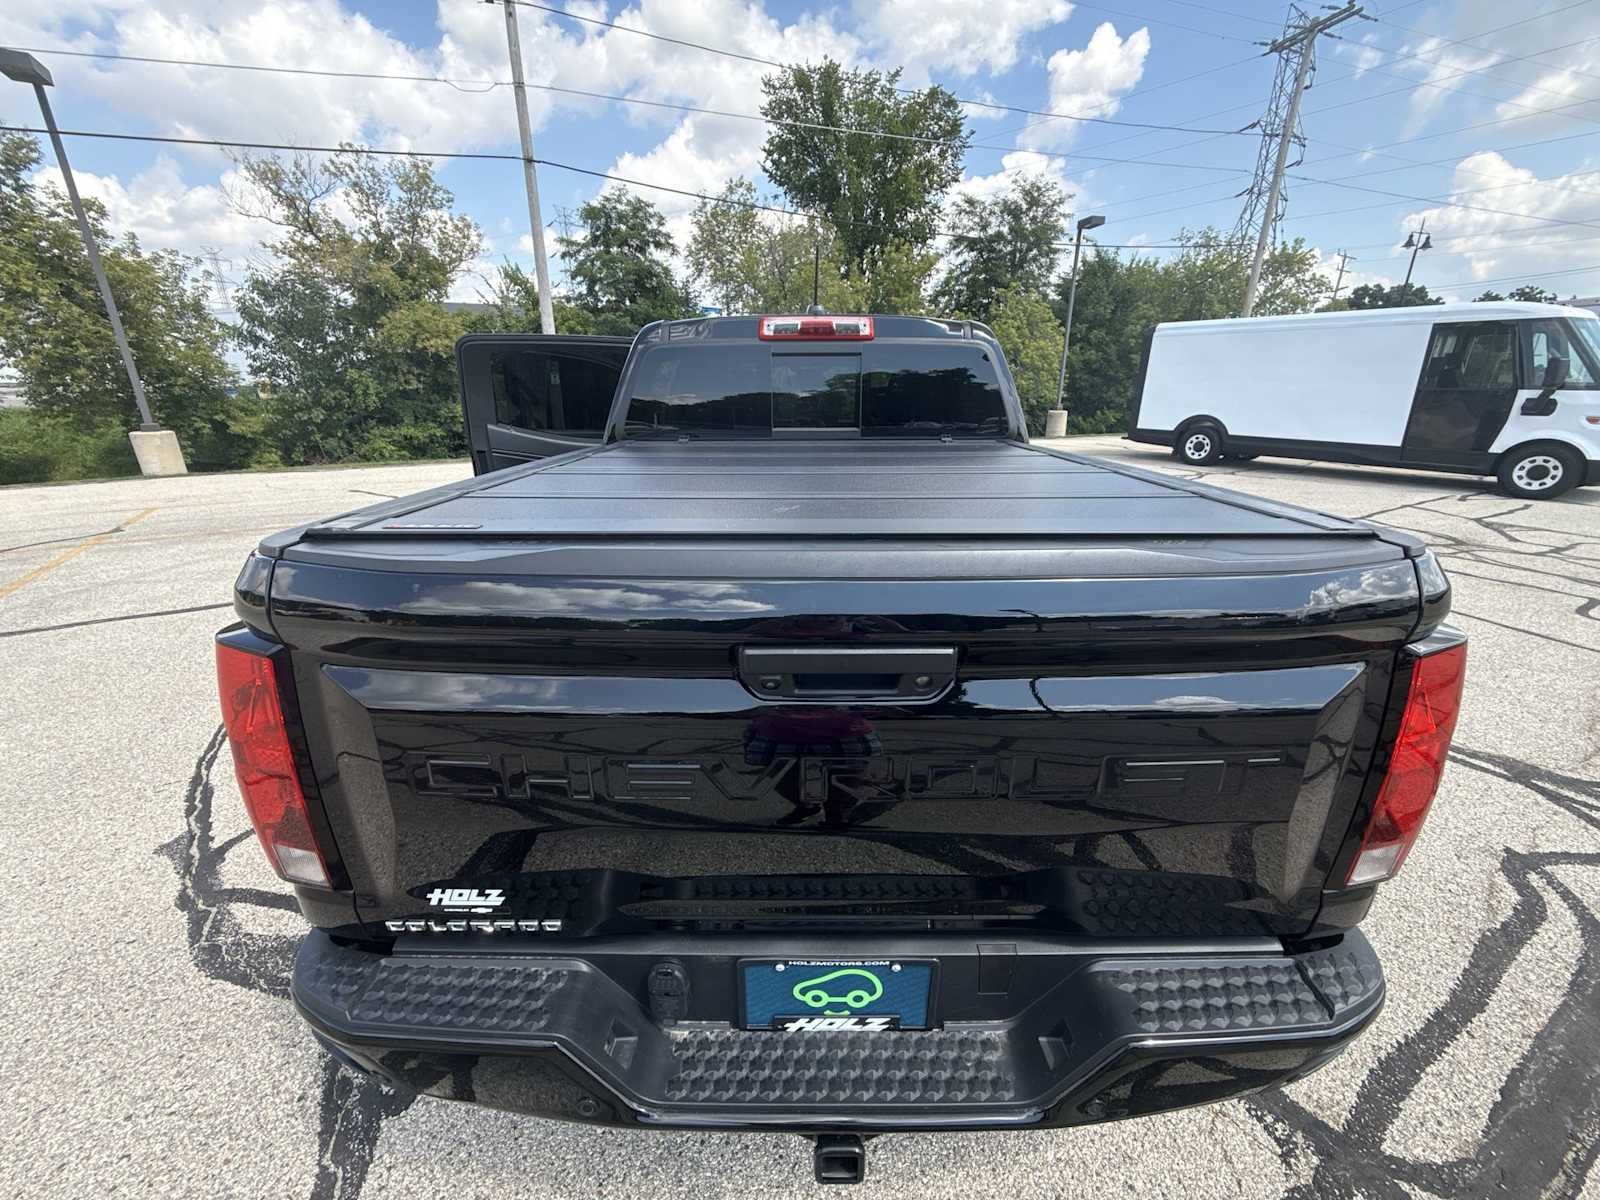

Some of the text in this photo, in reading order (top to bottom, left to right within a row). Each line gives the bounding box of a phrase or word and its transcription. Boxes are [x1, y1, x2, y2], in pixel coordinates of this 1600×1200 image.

[411, 751, 1286, 801] CHEVROLET
[426, 888, 506, 906] HOLZ
[385, 918, 562, 932] COLORADO
[788, 959, 890, 967] HOLZMOTORS.COM
[784, 1017, 891, 1032] HOLZ
